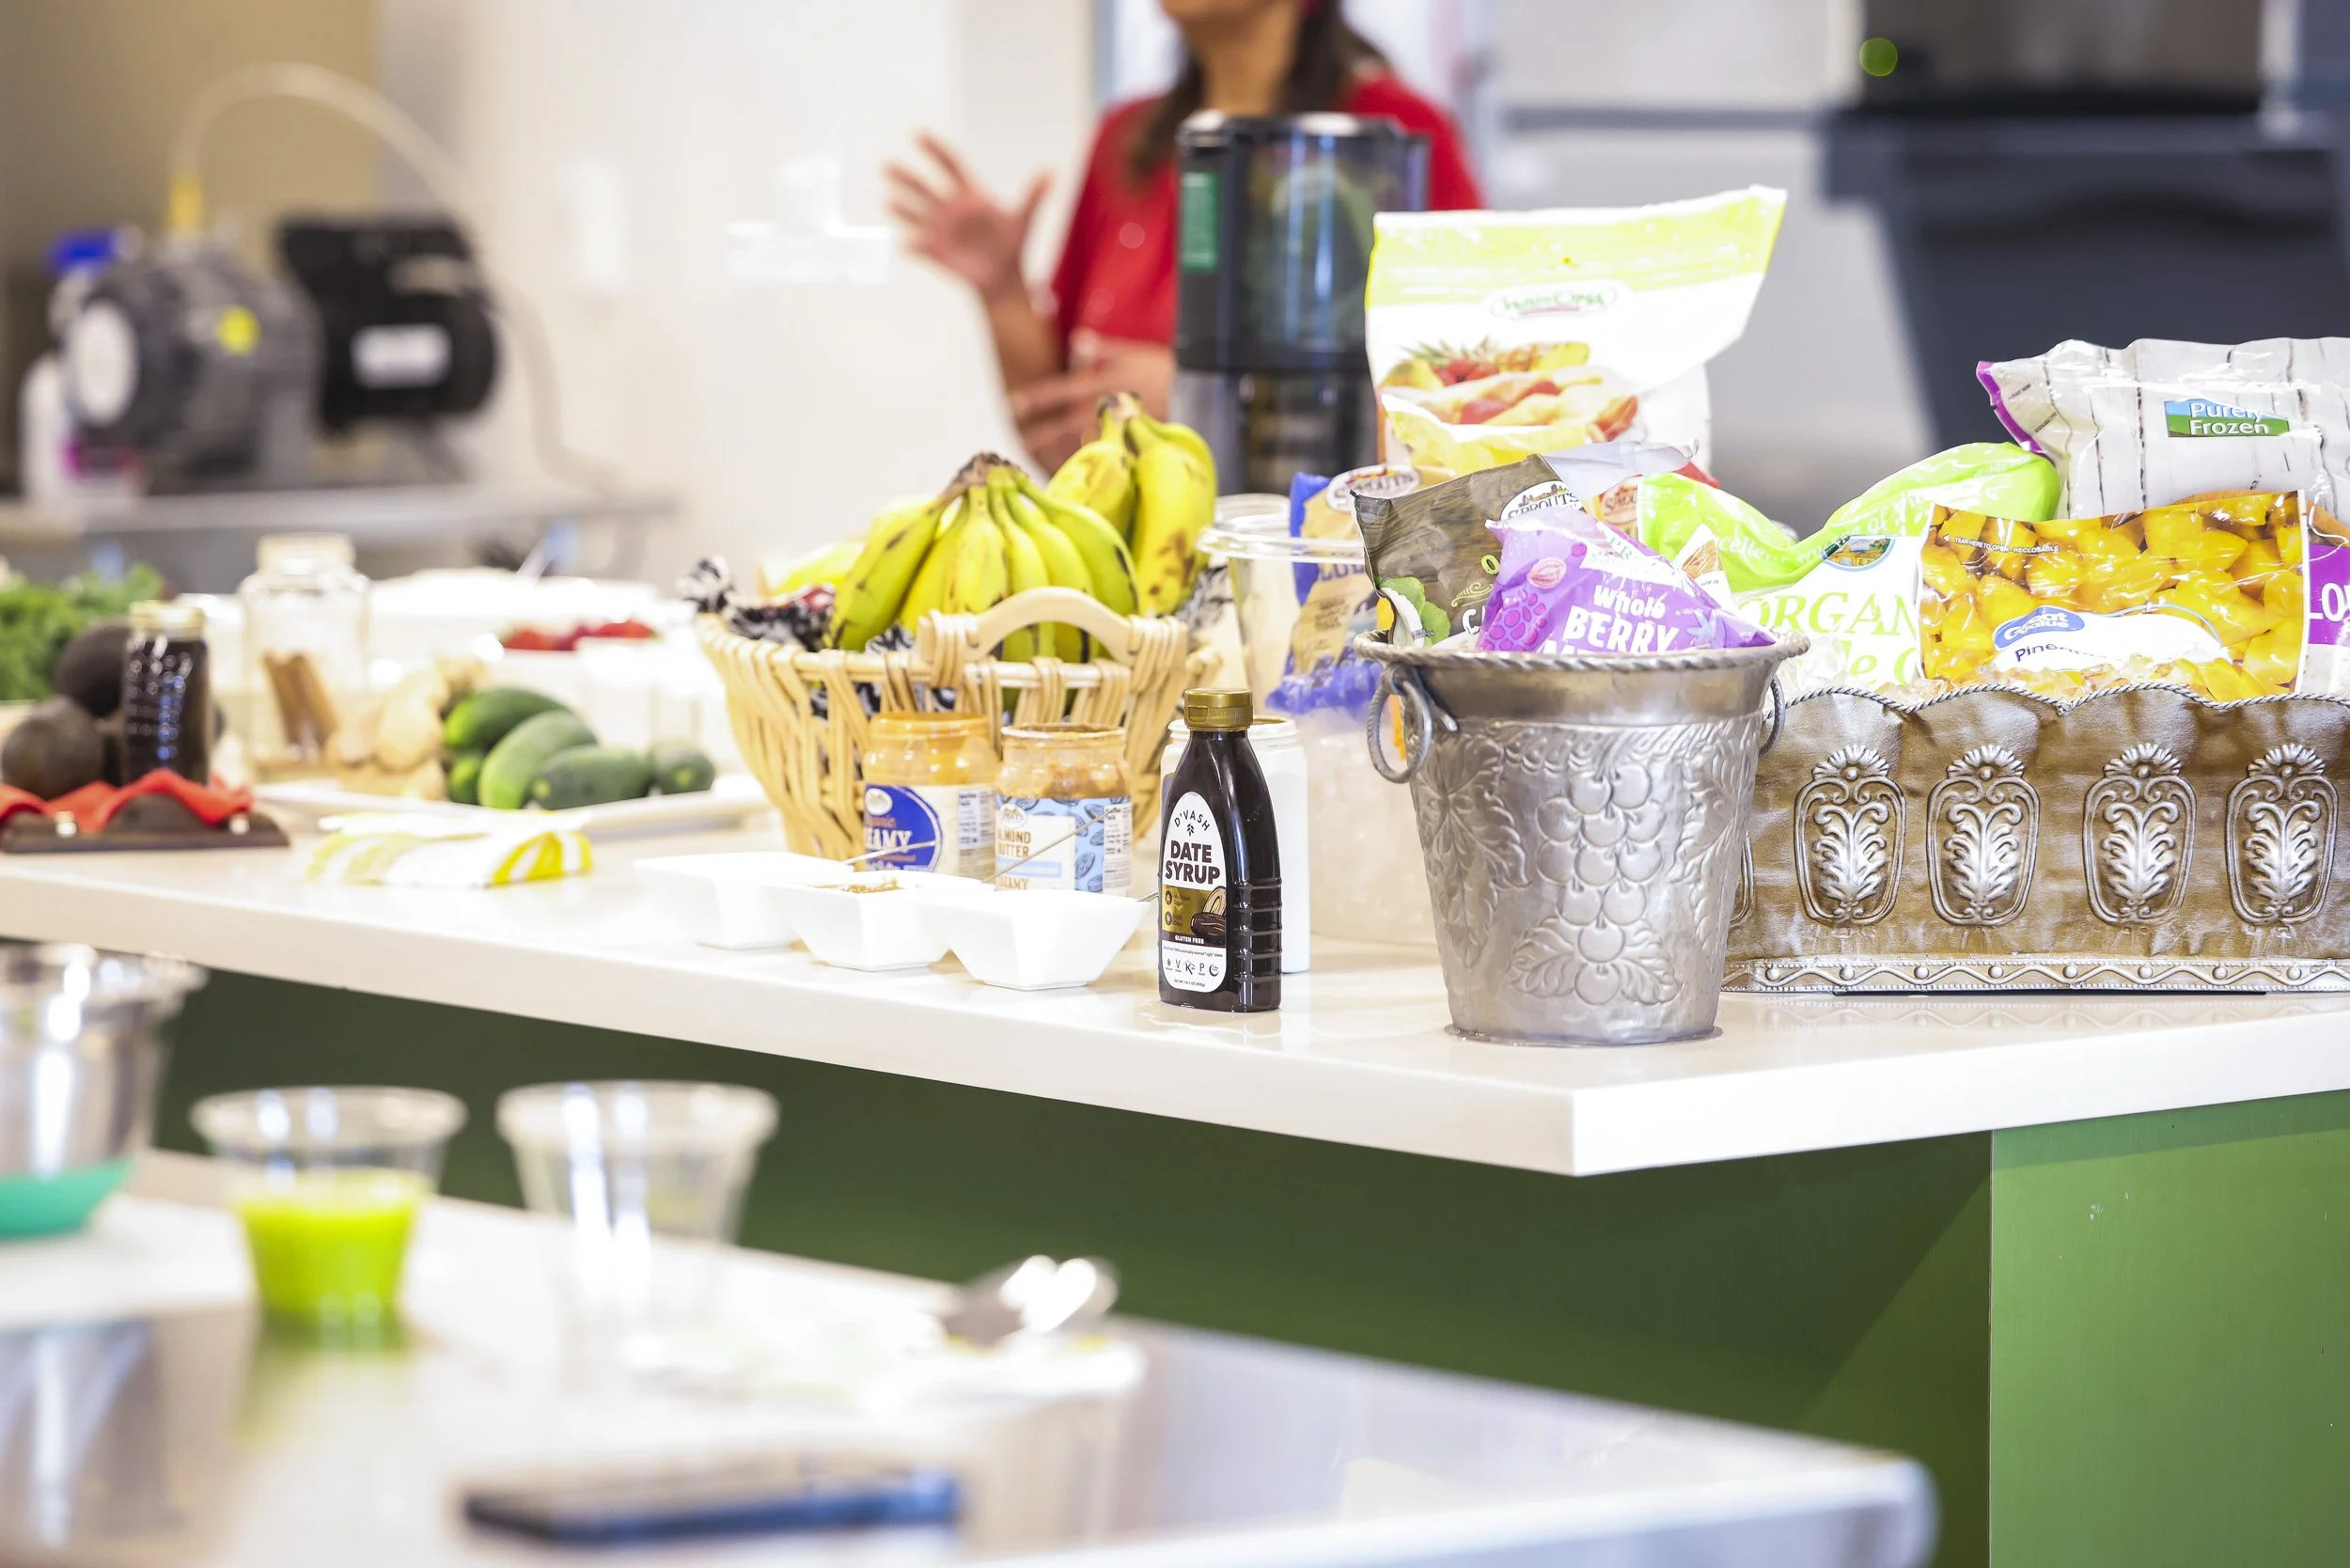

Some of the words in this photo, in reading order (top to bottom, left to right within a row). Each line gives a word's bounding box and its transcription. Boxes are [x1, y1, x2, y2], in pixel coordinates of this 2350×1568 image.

[2188, 420, 2269, 436] Frozen
[1562, 605, 1679, 653] BERRY
[1174, 809, 1211, 832] D'VASH
[1170, 839, 1213, 864] DATE
[1165, 859, 1221, 885] SYRUP
[1175, 934, 1192, 943] GLUTEN
